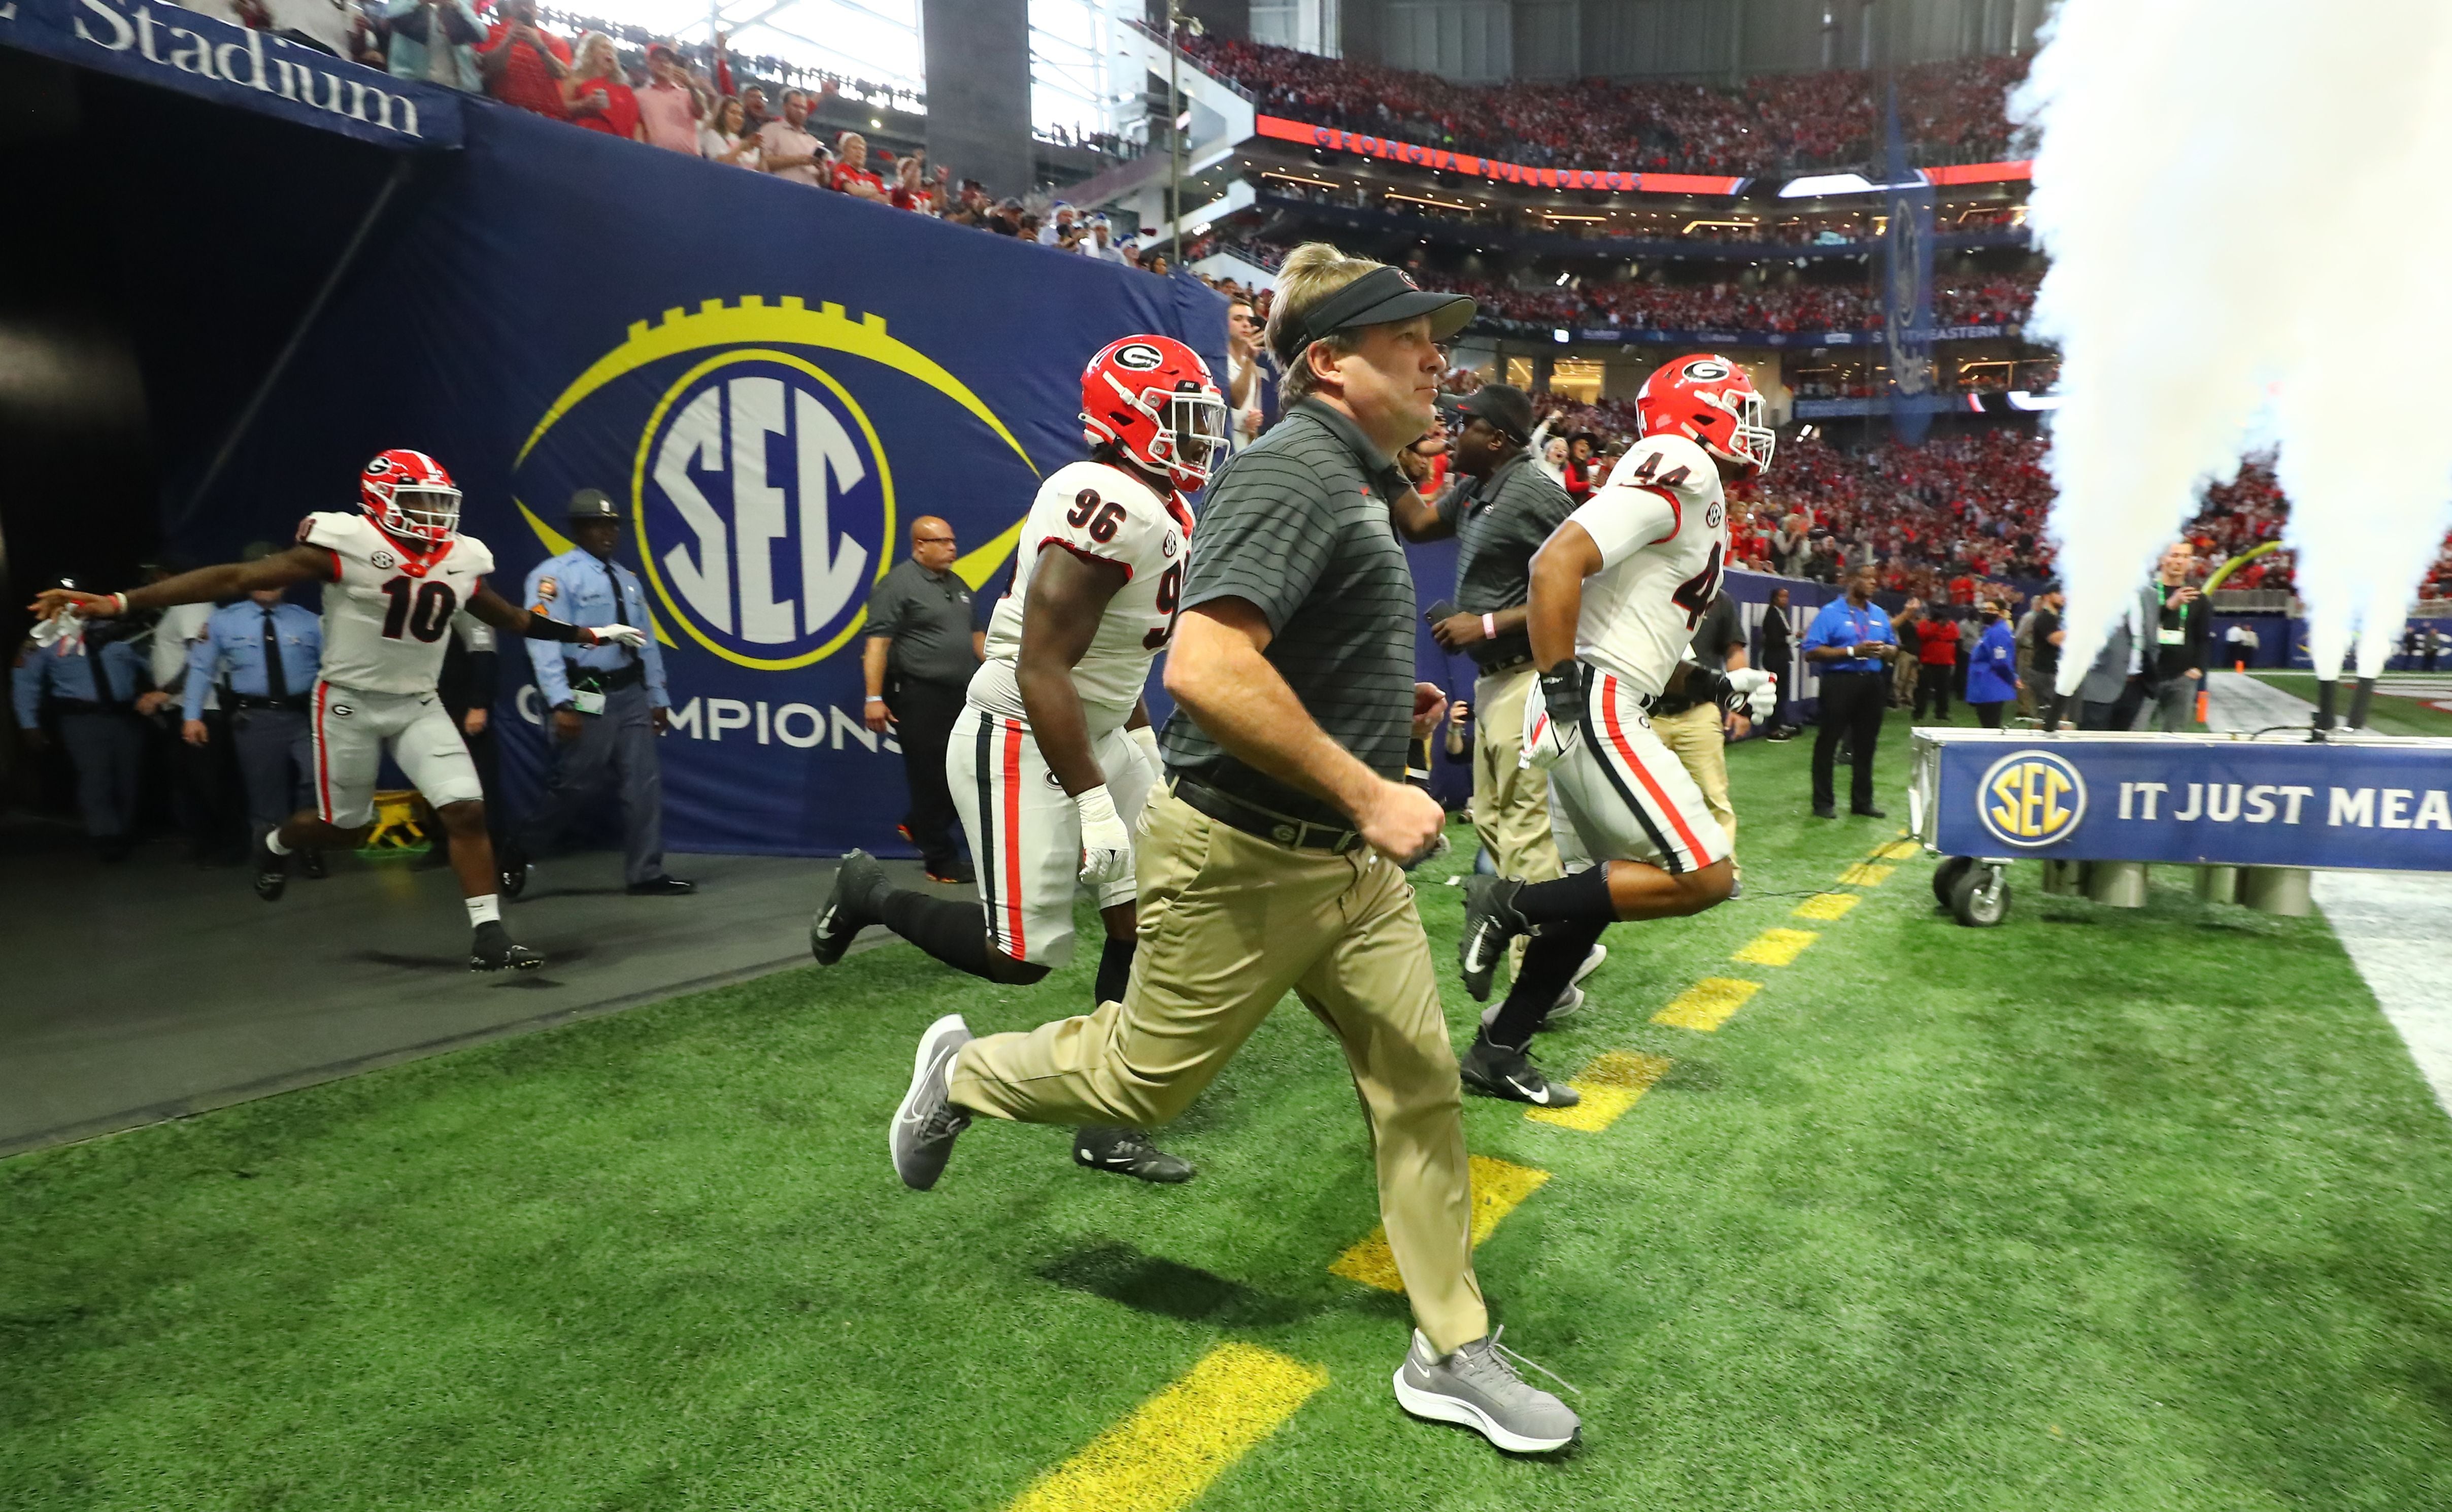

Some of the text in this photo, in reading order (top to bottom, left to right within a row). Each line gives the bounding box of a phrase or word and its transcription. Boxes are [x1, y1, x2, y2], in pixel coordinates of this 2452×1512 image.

[74, 0, 422, 138] Stadium
[1313, 126, 1642, 191] GEORGIA BULLDOGS
[1634, 452, 1692, 486] 44
[654, 376, 868, 645] SEC
[1067, 488, 1127, 544] 96
[382, 575, 456, 643] 10
[1143, 550, 1190, 650] 9
[1991, 762, 2072, 836] SEC
[2118, 782, 2452, 830] IT JUST MEA
